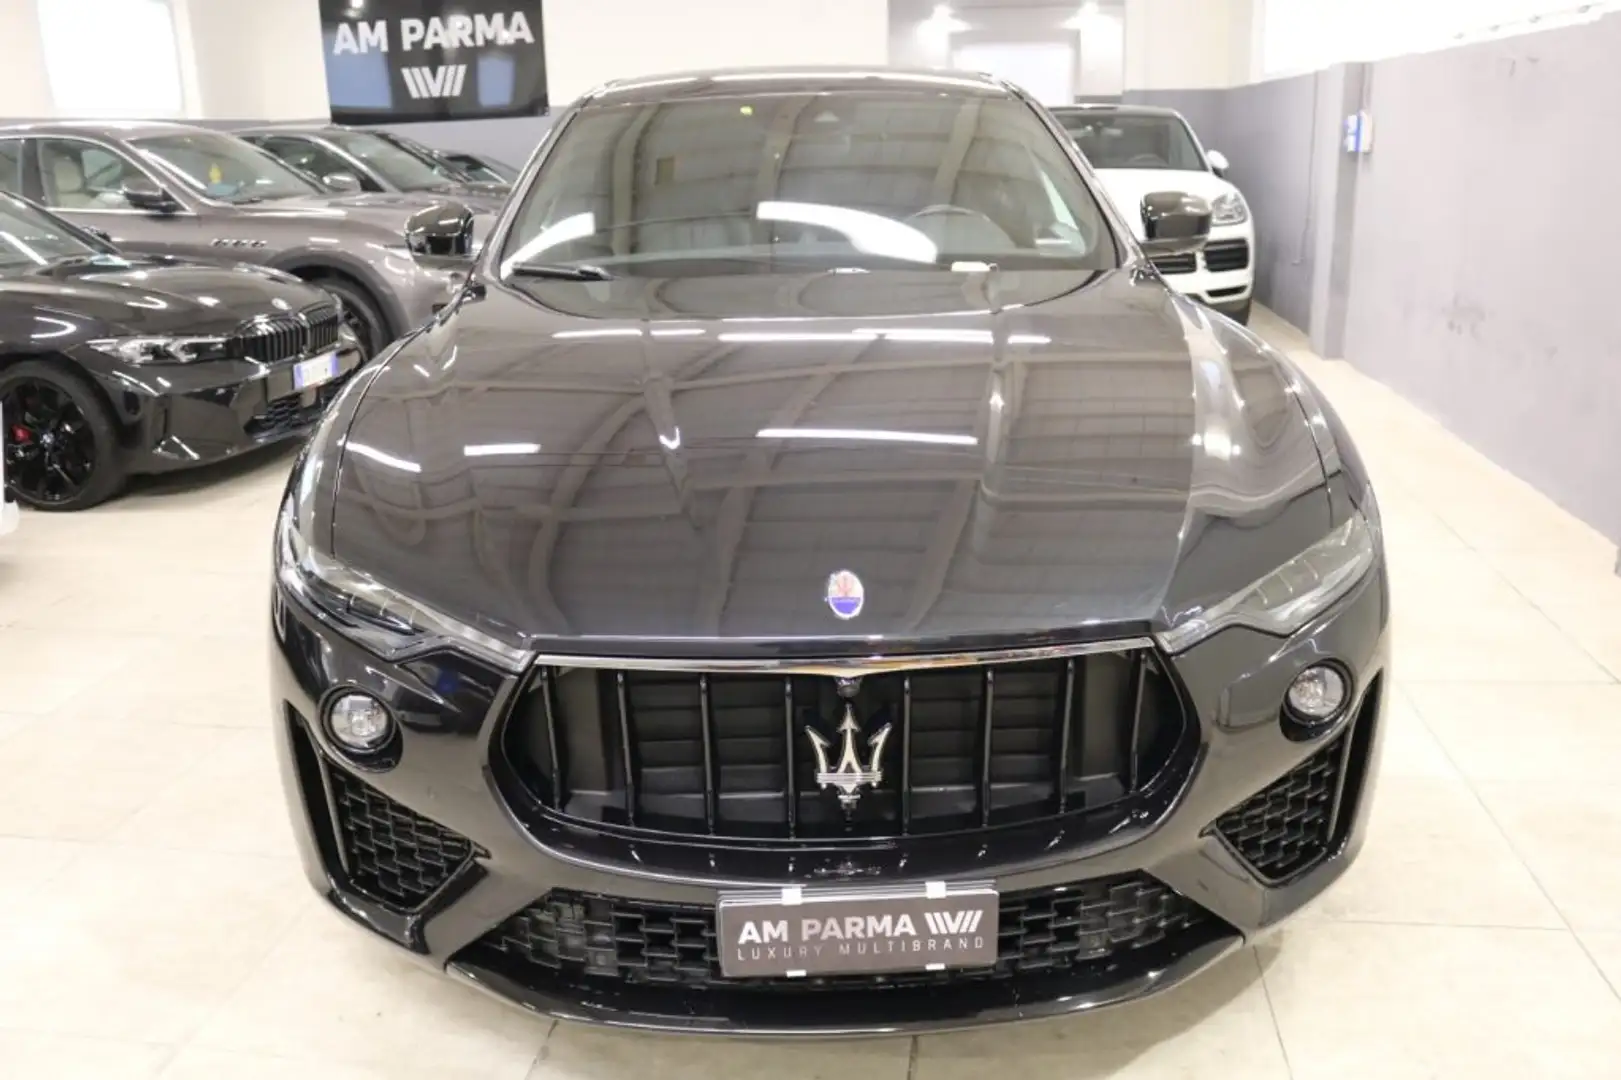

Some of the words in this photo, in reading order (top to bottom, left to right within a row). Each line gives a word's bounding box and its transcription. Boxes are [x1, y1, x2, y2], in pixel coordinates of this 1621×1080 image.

[333, 20, 389, 55] AM
[400, 11, 535, 51] PARMA
[738, 920, 788, 944] AM
[802, 914, 916, 940] PARMA
[737, 945, 822, 961] LUXURY
[838, 937, 985, 955] MULTIBRAND
